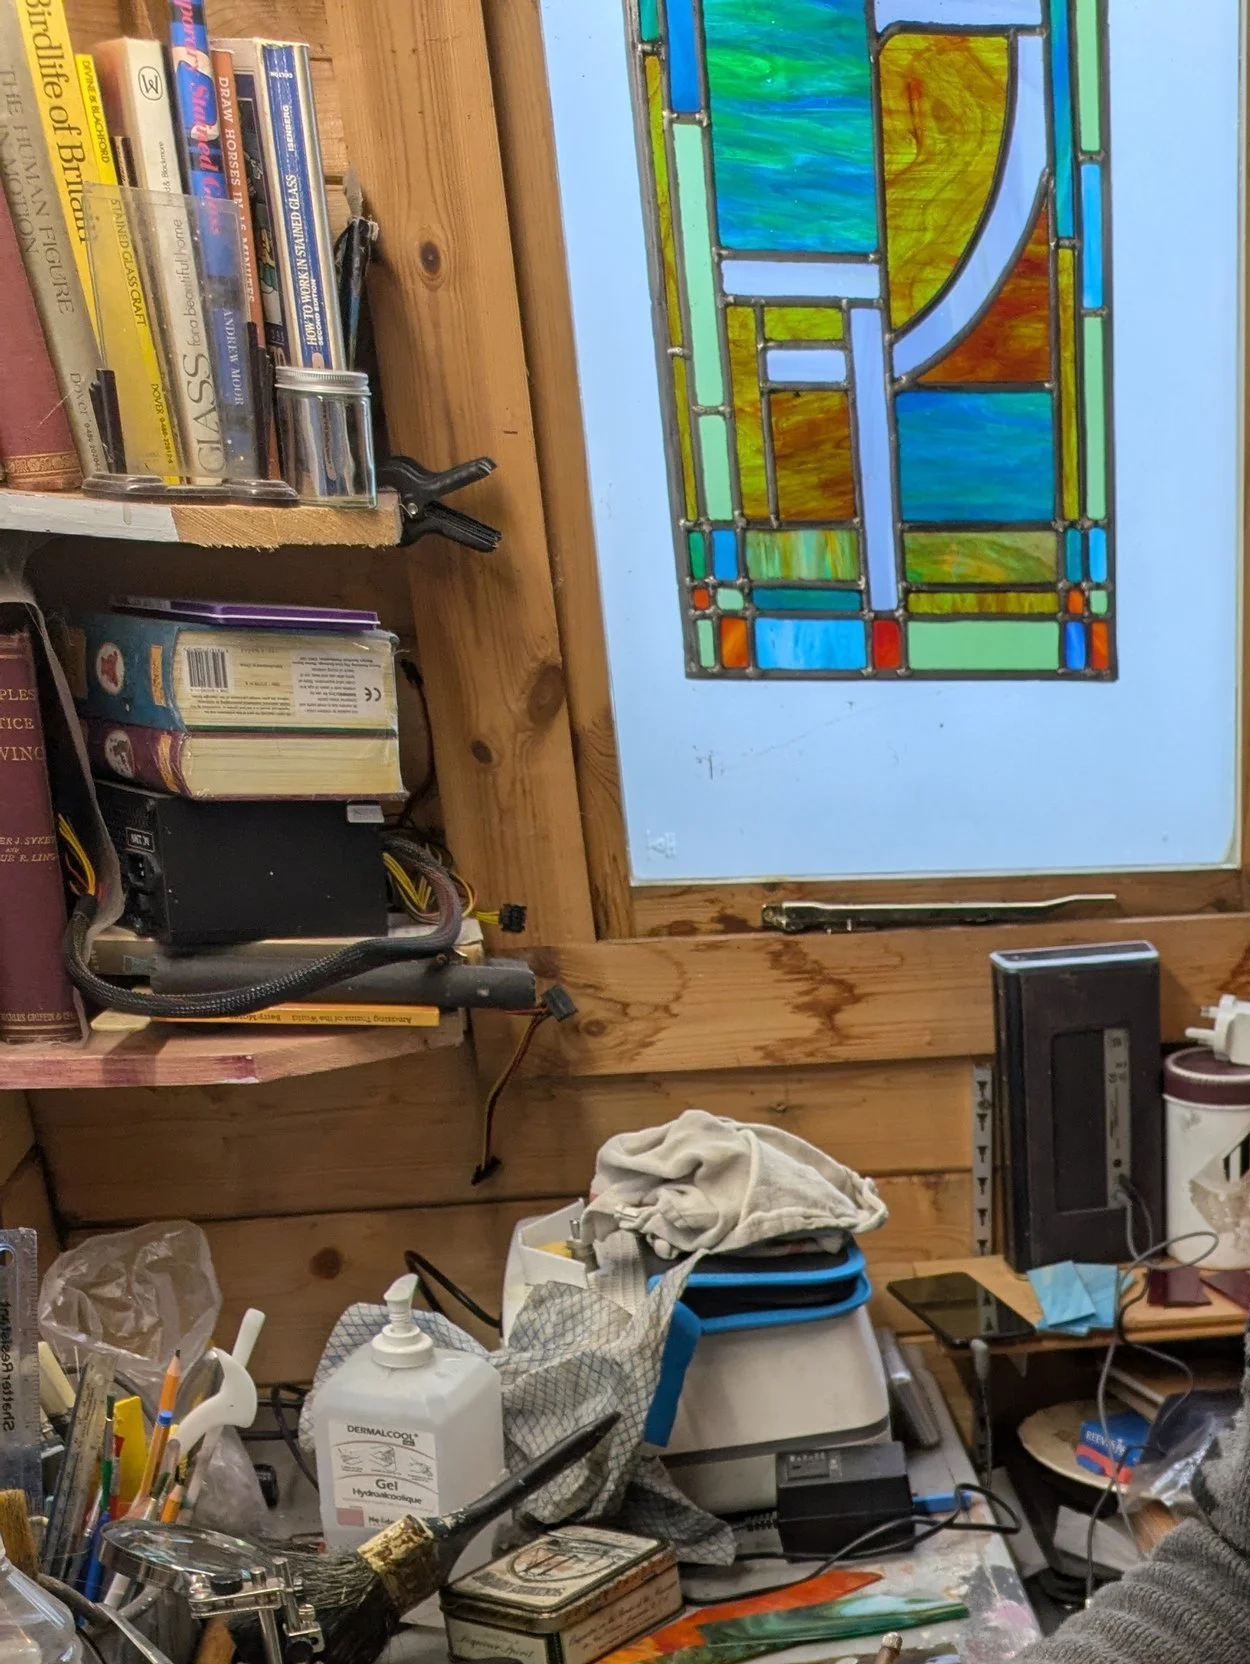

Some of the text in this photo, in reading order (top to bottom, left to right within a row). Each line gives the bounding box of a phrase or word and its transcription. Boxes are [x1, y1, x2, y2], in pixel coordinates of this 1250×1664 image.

[50, 105, 82, 136] of
[82, 60, 94, 91] DIVINE
[92, 105, 111, 163] BLACHFORD
[218, 76, 233, 123] DRAW
[282, 105, 296, 152] ISENBERG
[224, 128, 241, 187] HORSES
[0, 65, 75, 314] THE HUMAN FIGURE
[3, 157, 39, 254] MOTION
[286, 174, 303, 212] GLASS
[175, 219, 189, 250] home
[291, 213, 307, 258] STAINED
[111, 199, 129, 249] STAINED
[121, 250, 139, 290] GLASS
[131, 290, 147, 327] CRAFT
[176, 252, 199, 316] beautiful
[298, 271, 313, 305] WORK
[303, 305, 315, 321] TO
[306, 321, 319, 347] HOW
[310, 279, 325, 347] SECOND EDITION
[222, 308, 245, 406] ANDREW MOOR
[151, 383, 164, 414] DOVER
[183, 353, 227, 475] GLASS
[375, 1478, 398, 1491] Gel
